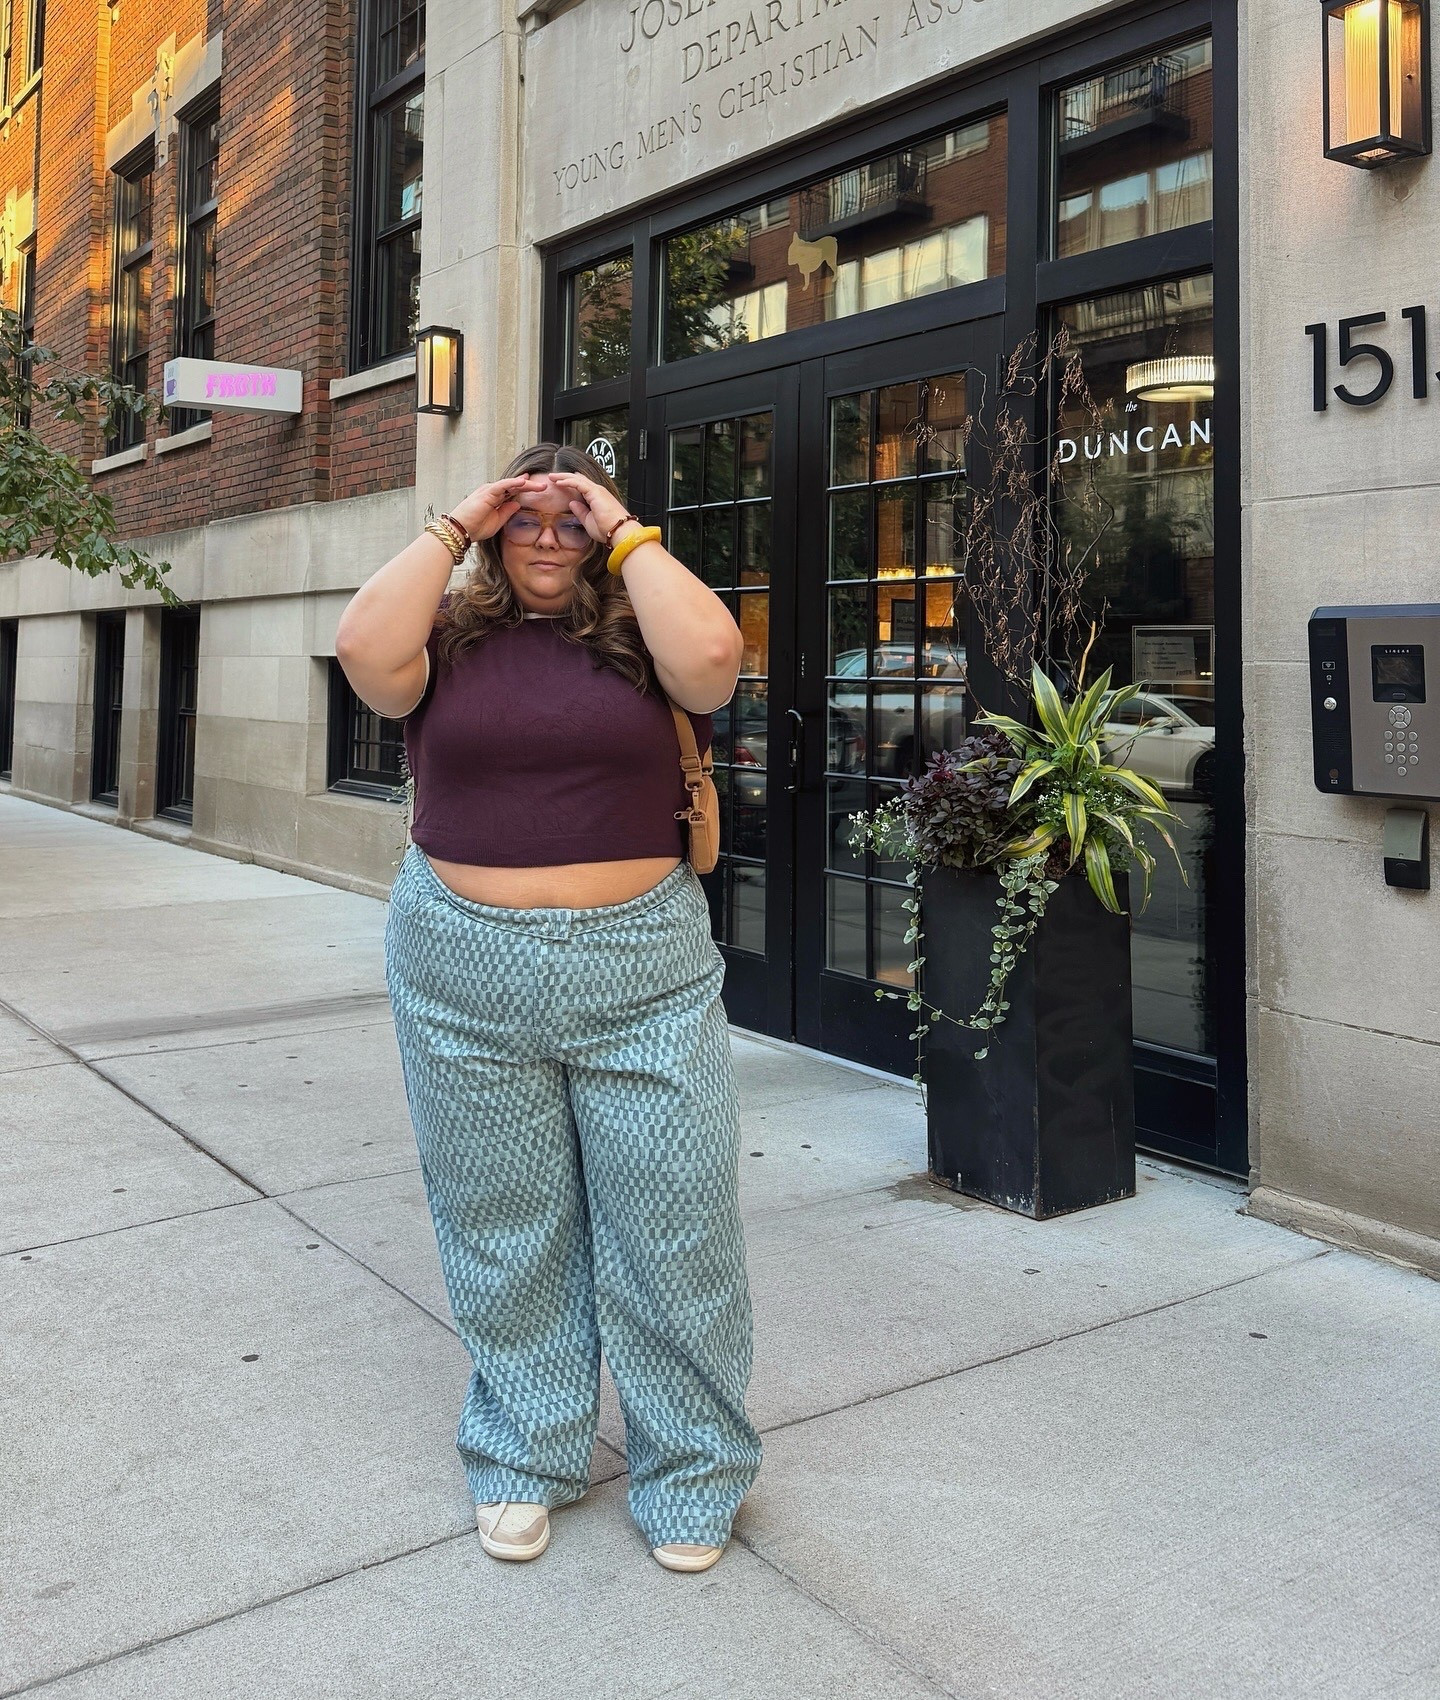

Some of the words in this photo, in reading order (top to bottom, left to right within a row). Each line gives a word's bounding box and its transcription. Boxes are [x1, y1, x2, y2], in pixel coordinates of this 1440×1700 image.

[553, 141, 624, 196] YOUNG
[637, 102, 702, 160] MEN'S
[718, 16, 880, 119] CHRISTIAN
[1304, 305, 1440, 412] 151
[206, 372, 277, 398] FROTH
[1124, 401, 1138, 413] the
[1058, 418, 1210, 464] DUNCAN
